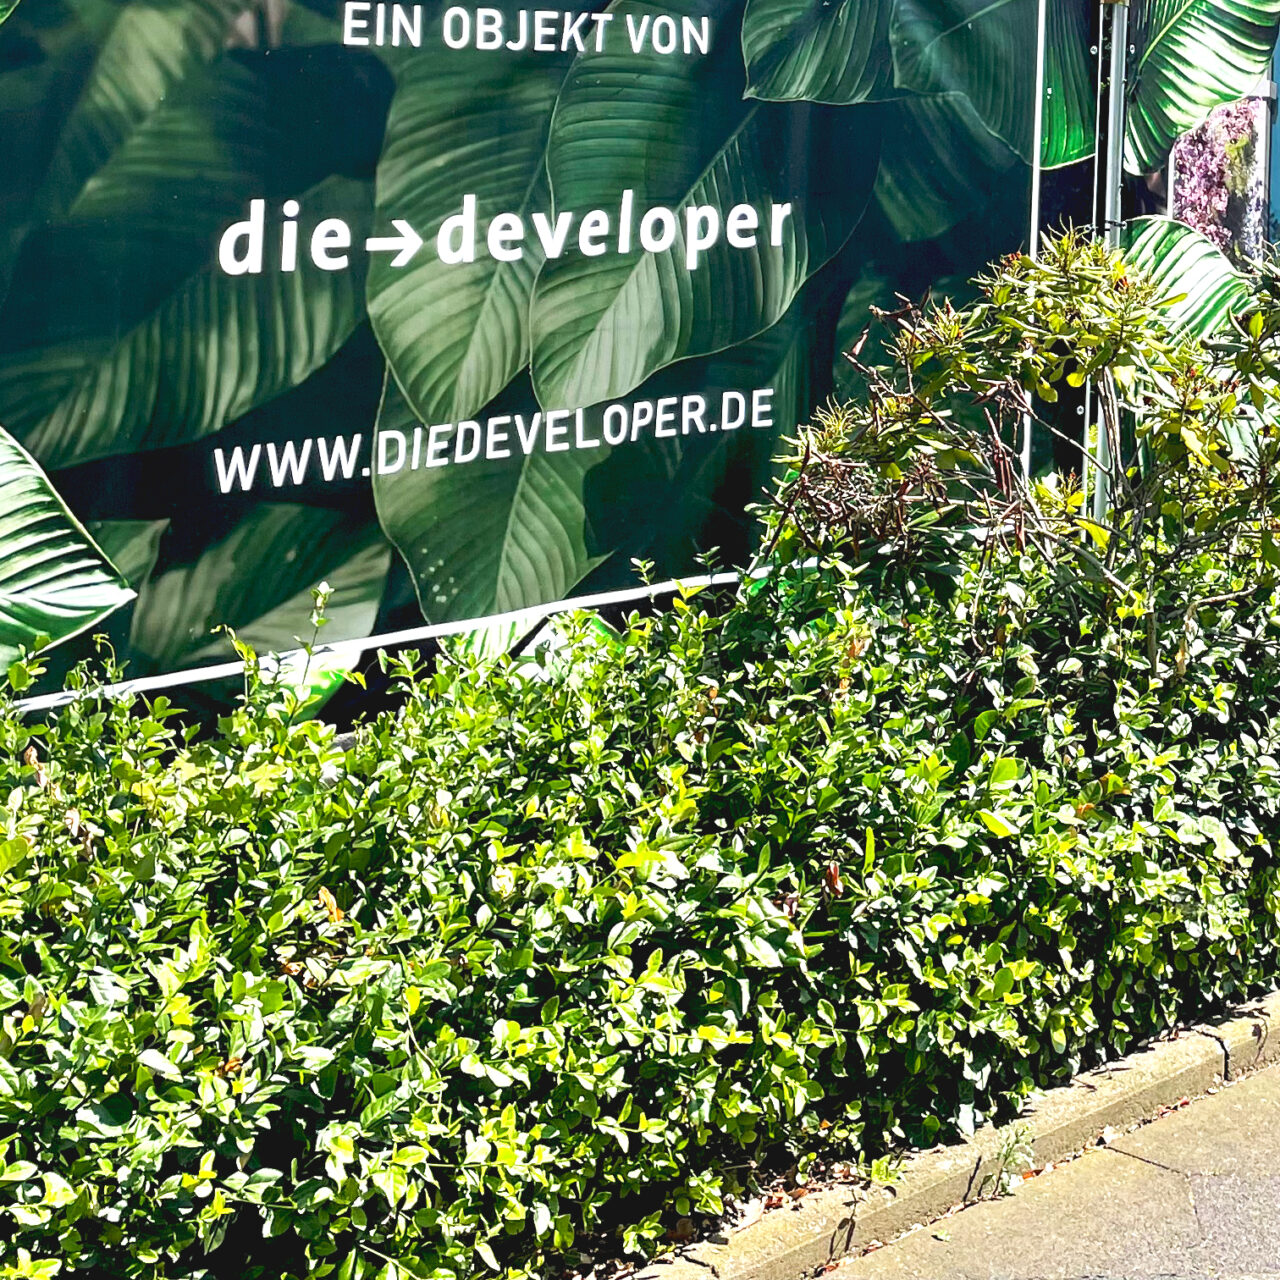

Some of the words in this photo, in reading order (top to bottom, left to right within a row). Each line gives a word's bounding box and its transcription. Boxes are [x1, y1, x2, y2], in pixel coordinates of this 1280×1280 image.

[342, 0, 423, 49] EIN
[443, 5, 613, 54] OBJEKT
[626, 12, 710, 56] VON
[217, 197, 352, 277] die
[433, 189, 793, 272] developer
[212, 387, 775, 495] WWW.DIEDEVELOPER.DE
